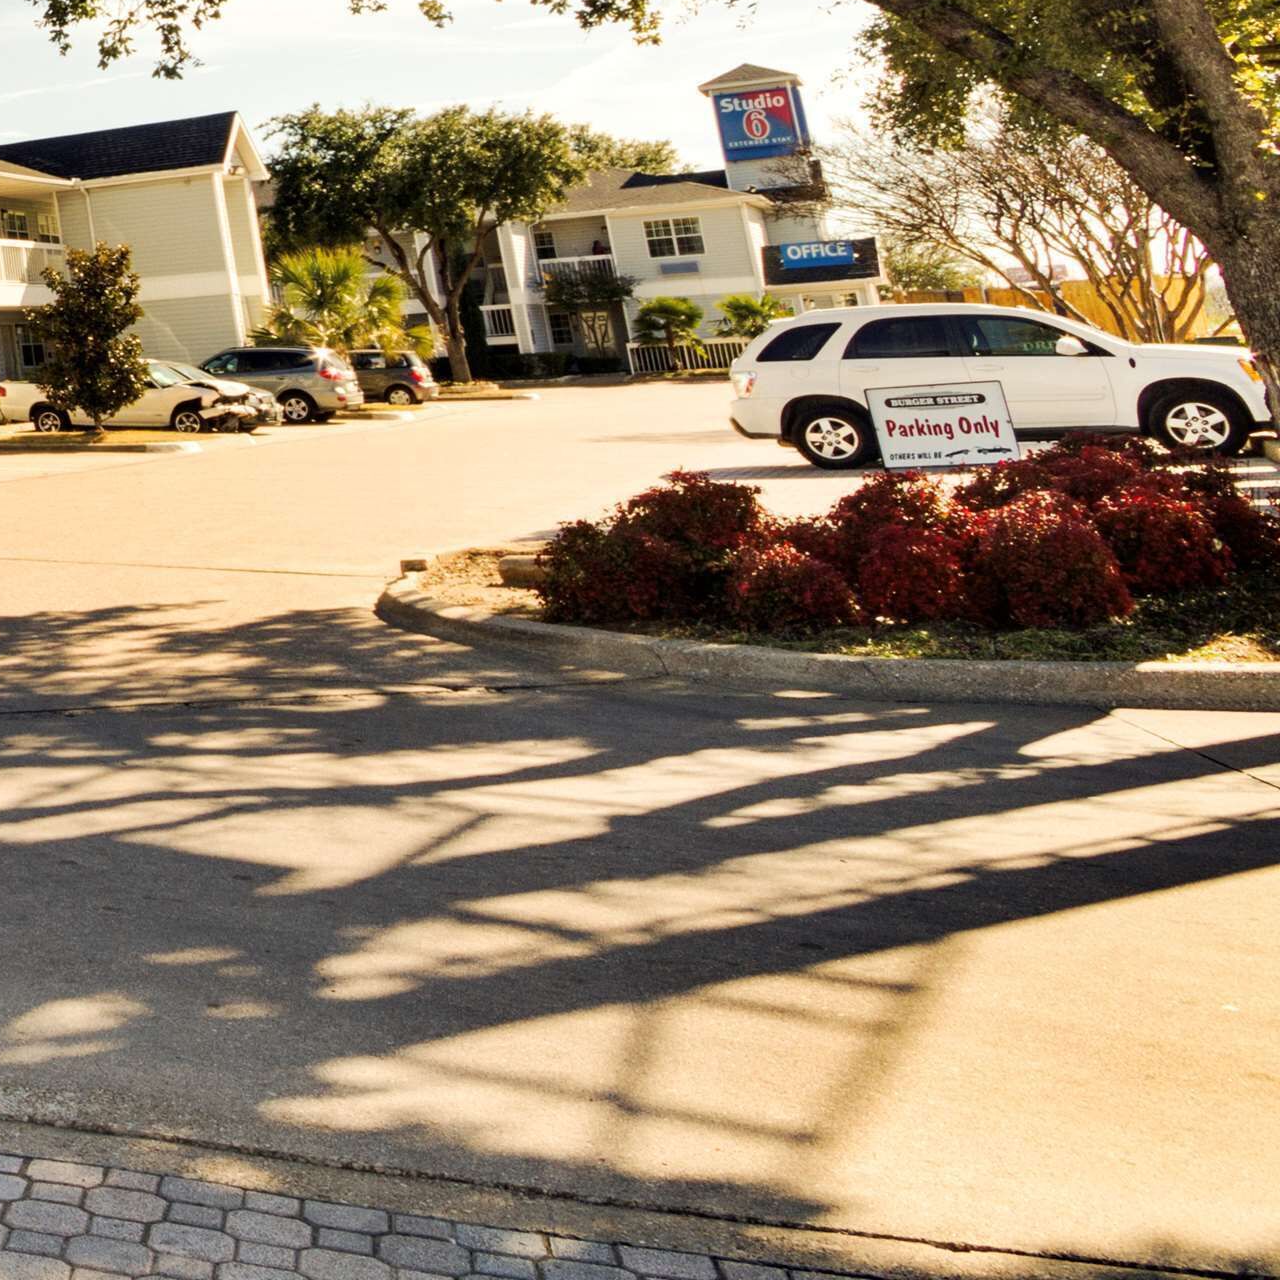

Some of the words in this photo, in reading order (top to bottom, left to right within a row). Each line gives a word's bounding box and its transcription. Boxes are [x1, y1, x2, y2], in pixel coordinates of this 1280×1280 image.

[720, 93, 785, 113] Studio
[743, 109, 770, 139] 6
[786, 242, 848, 260] OFFICE
[890, 396, 935, 407] BURGER
[937, 394, 980, 405] STREET
[885, 418, 955, 441] Parking
[958, 415, 1001, 438] Only
[890, 452, 916, 461] OTHERS
[917, 452, 932, 460] WILL
